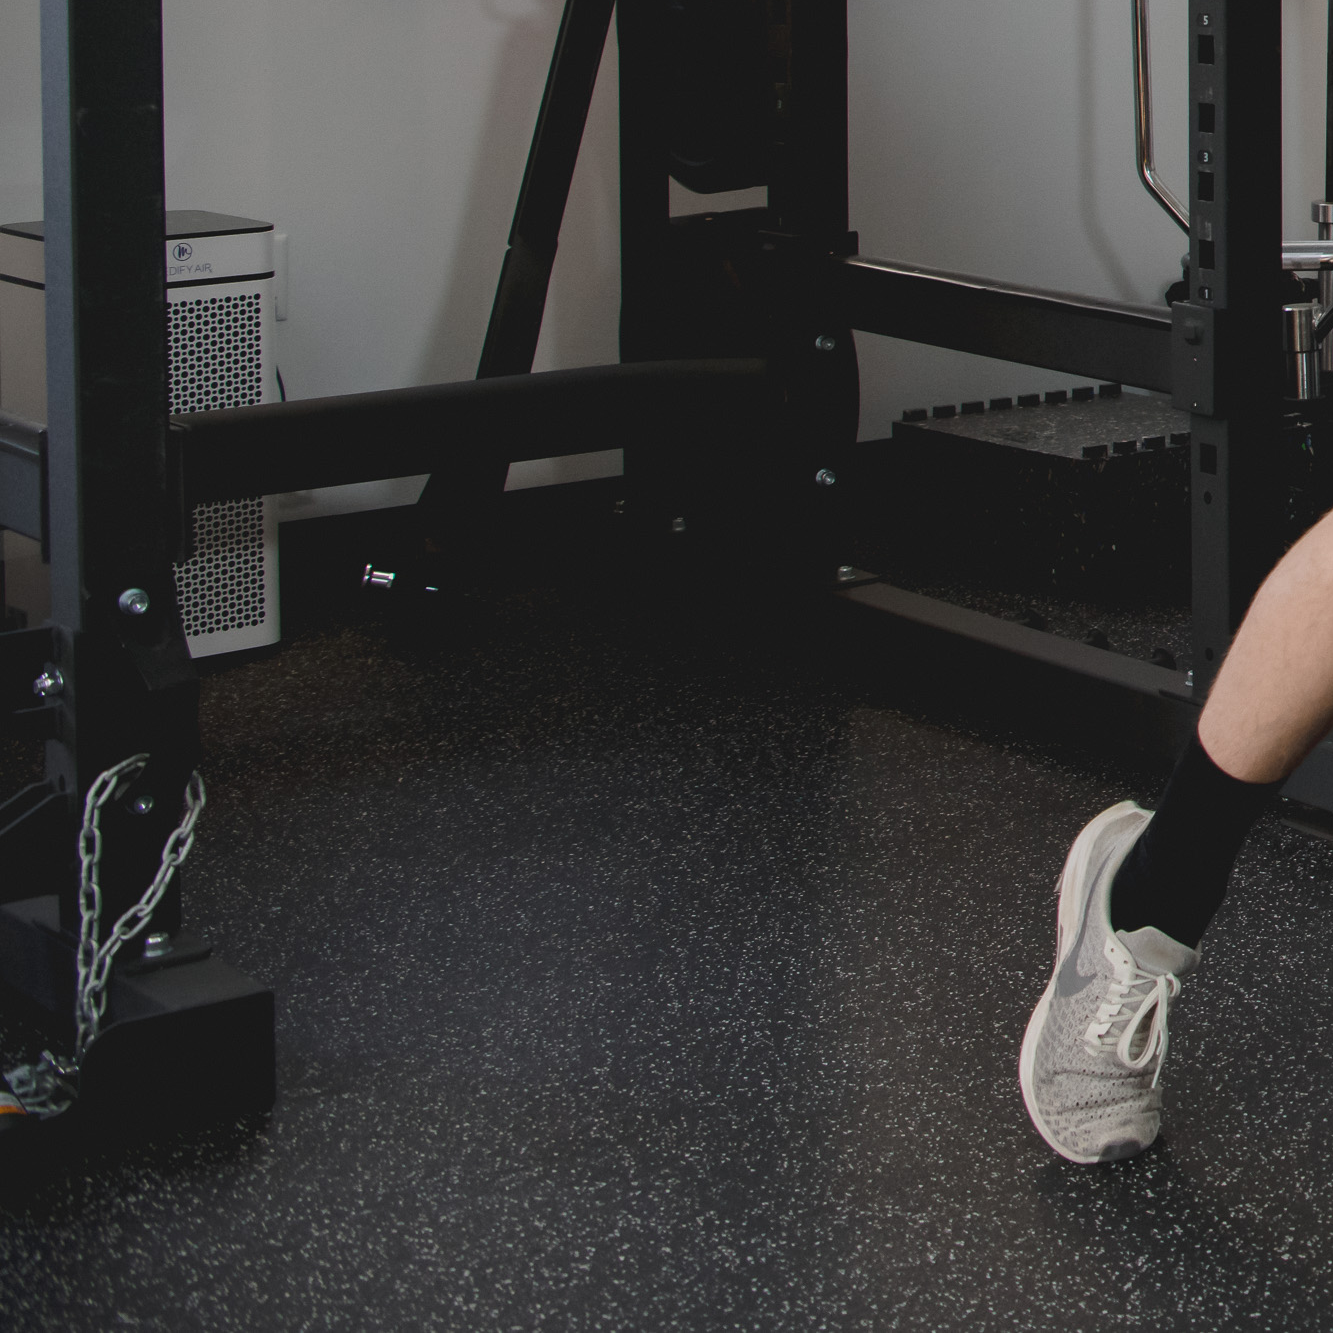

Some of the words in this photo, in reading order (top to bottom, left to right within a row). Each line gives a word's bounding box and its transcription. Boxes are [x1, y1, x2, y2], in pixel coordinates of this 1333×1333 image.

[1203, 15, 1209, 25] 5
[1203, 152, 1209, 162] 3
[169, 265, 193, 276] DIFY
